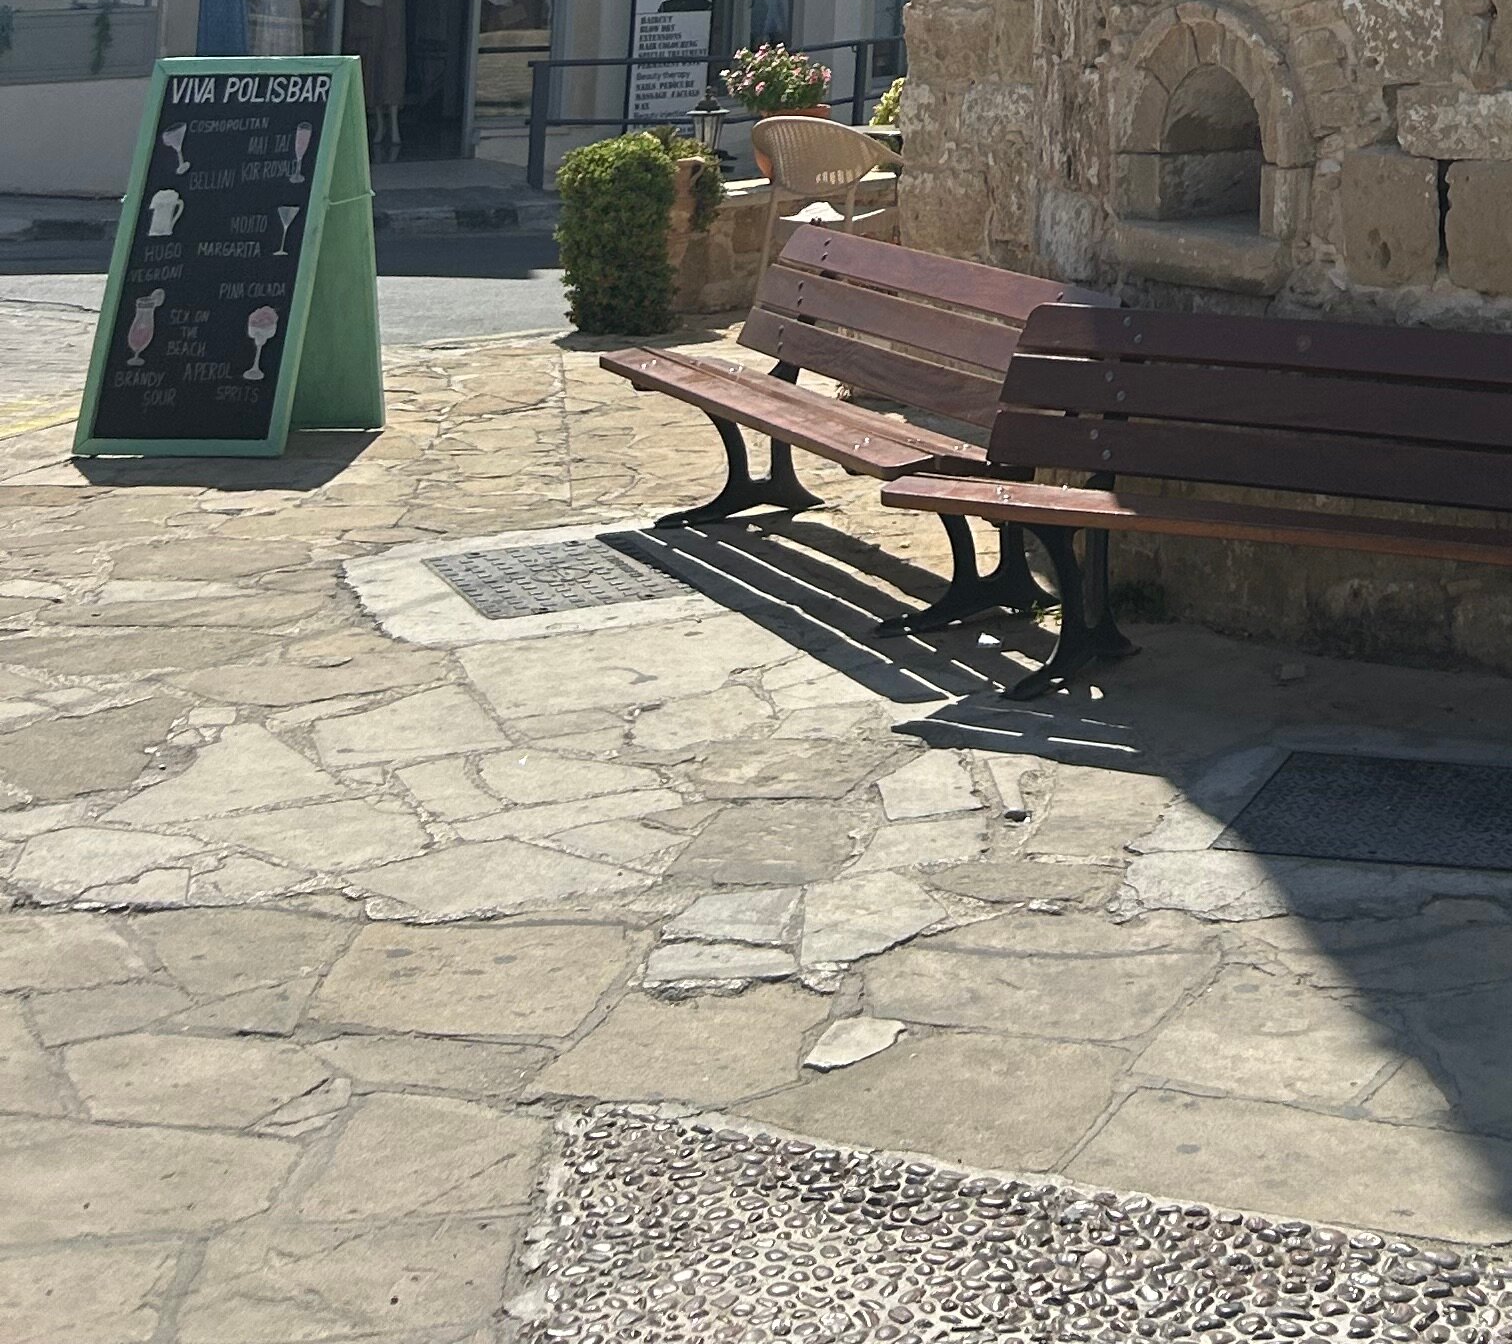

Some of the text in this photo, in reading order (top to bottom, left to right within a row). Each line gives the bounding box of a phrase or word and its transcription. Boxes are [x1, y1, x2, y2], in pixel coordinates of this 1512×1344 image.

[172, 76, 215, 104] VIVA
[189, 117, 270, 133] COSMOPOLITAN
[189, 169, 236, 190] BELLINI
[144, 242, 183, 262] HUGO
[197, 241, 261, 259] MARGARITA
[167, 341, 206, 357] BEACH
[183, 363, 233, 382] APEROL
[143, 388, 177, 410] SOUR
